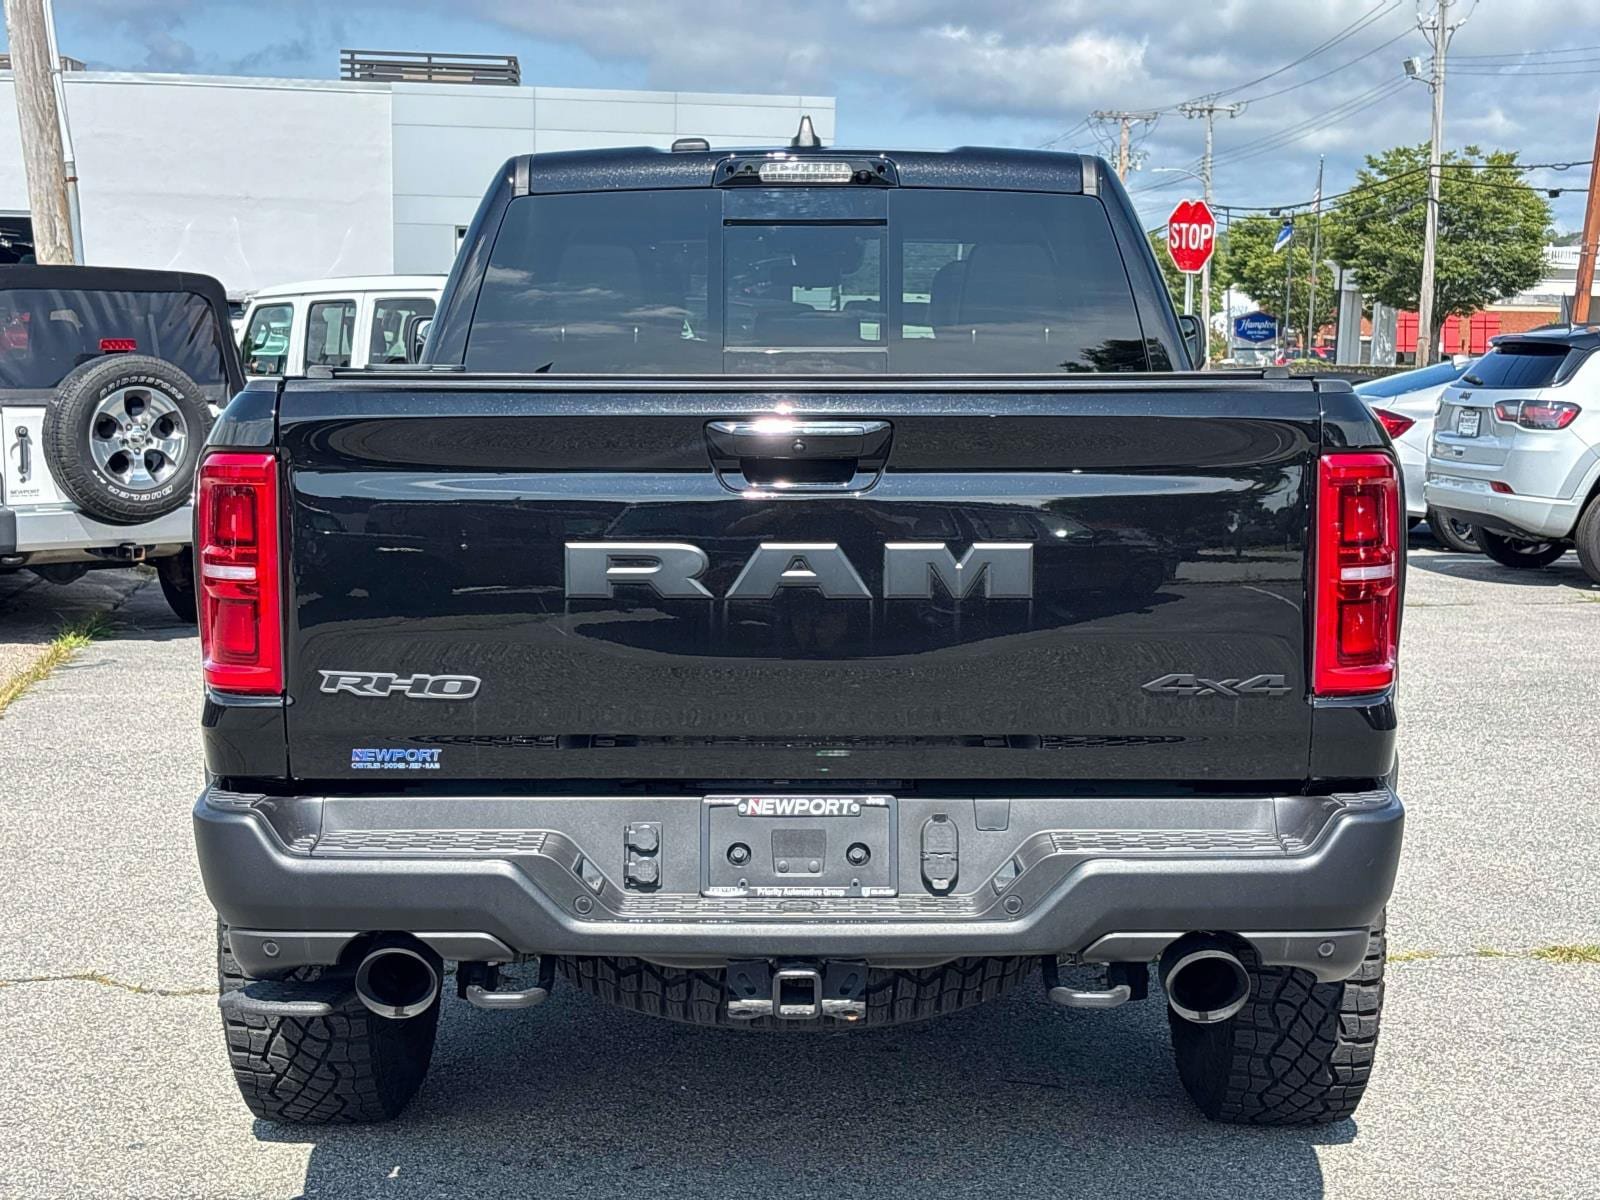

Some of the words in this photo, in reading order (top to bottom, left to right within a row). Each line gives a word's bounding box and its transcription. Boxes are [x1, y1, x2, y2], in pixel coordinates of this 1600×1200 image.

[1171, 223, 1212, 250] STOP
[1238, 319, 1277, 331] Hampton
[100, 375, 184, 399] BRIDGESTONE
[565, 542, 1034, 599] RAM
[318, 669, 482, 700] RHO
[351, 748, 442, 762] NEWPORT
[746, 798, 854, 816] NEWPORT
[757, 887, 782, 897] Priority
[783, 887, 821, 897] Automotive
[823, 887, 846, 897] Group
